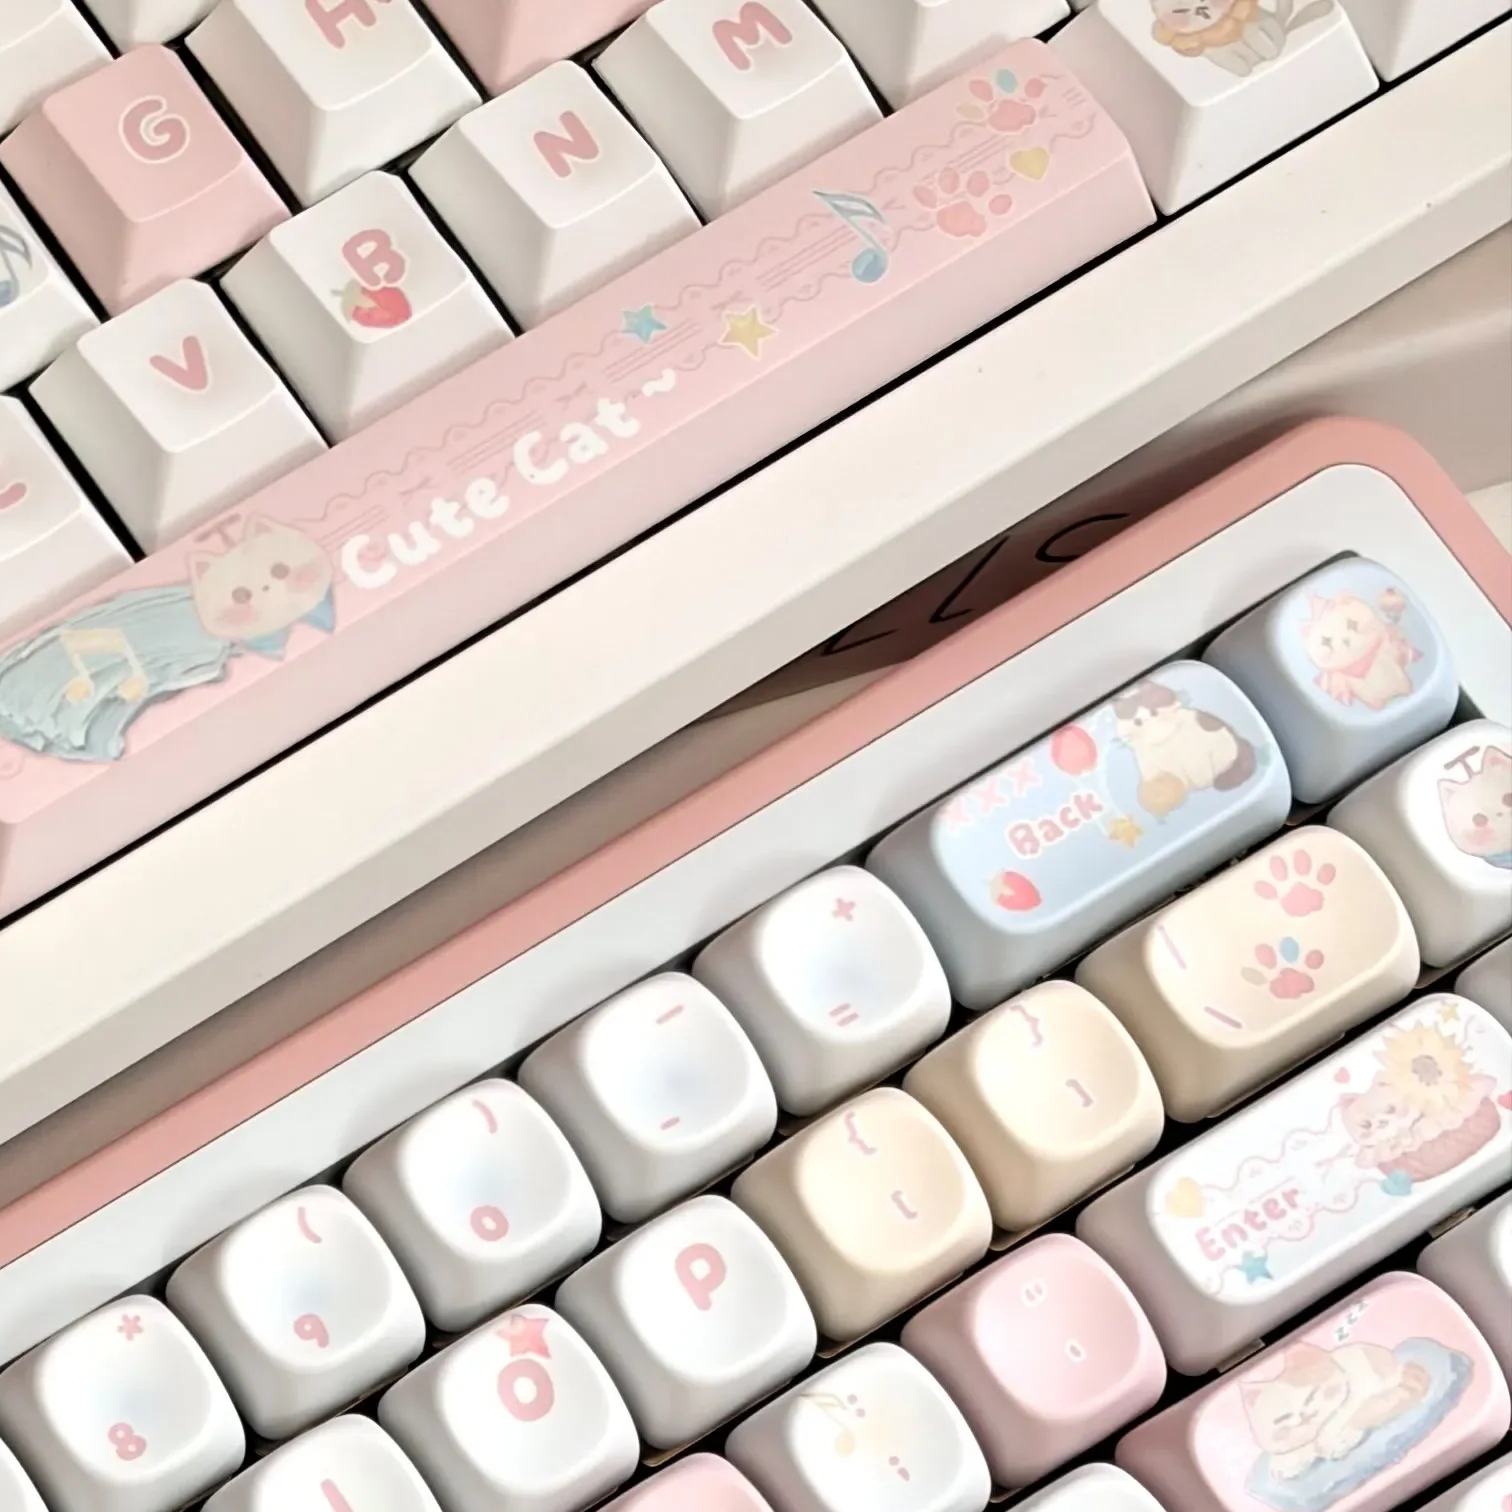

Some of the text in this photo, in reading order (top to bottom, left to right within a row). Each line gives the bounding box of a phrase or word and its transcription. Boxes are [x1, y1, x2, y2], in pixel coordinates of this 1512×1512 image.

[712, 1, 792, 71] M
[120, 97, 189, 163] G
[533, 110, 599, 178] N
[341, 228, 405, 287] B
[150, 336, 208, 391] V
[342, 478, 509, 589] Cute
[1007, 792, 1104, 857] Back
[1194, 1187, 1292, 1261] Enter
[675, 1243, 727, 1310] P
[294, 1313, 329, 1348] 9
[497, 1358, 555, 1422] O
[108, 1422, 146, 1460] 8
